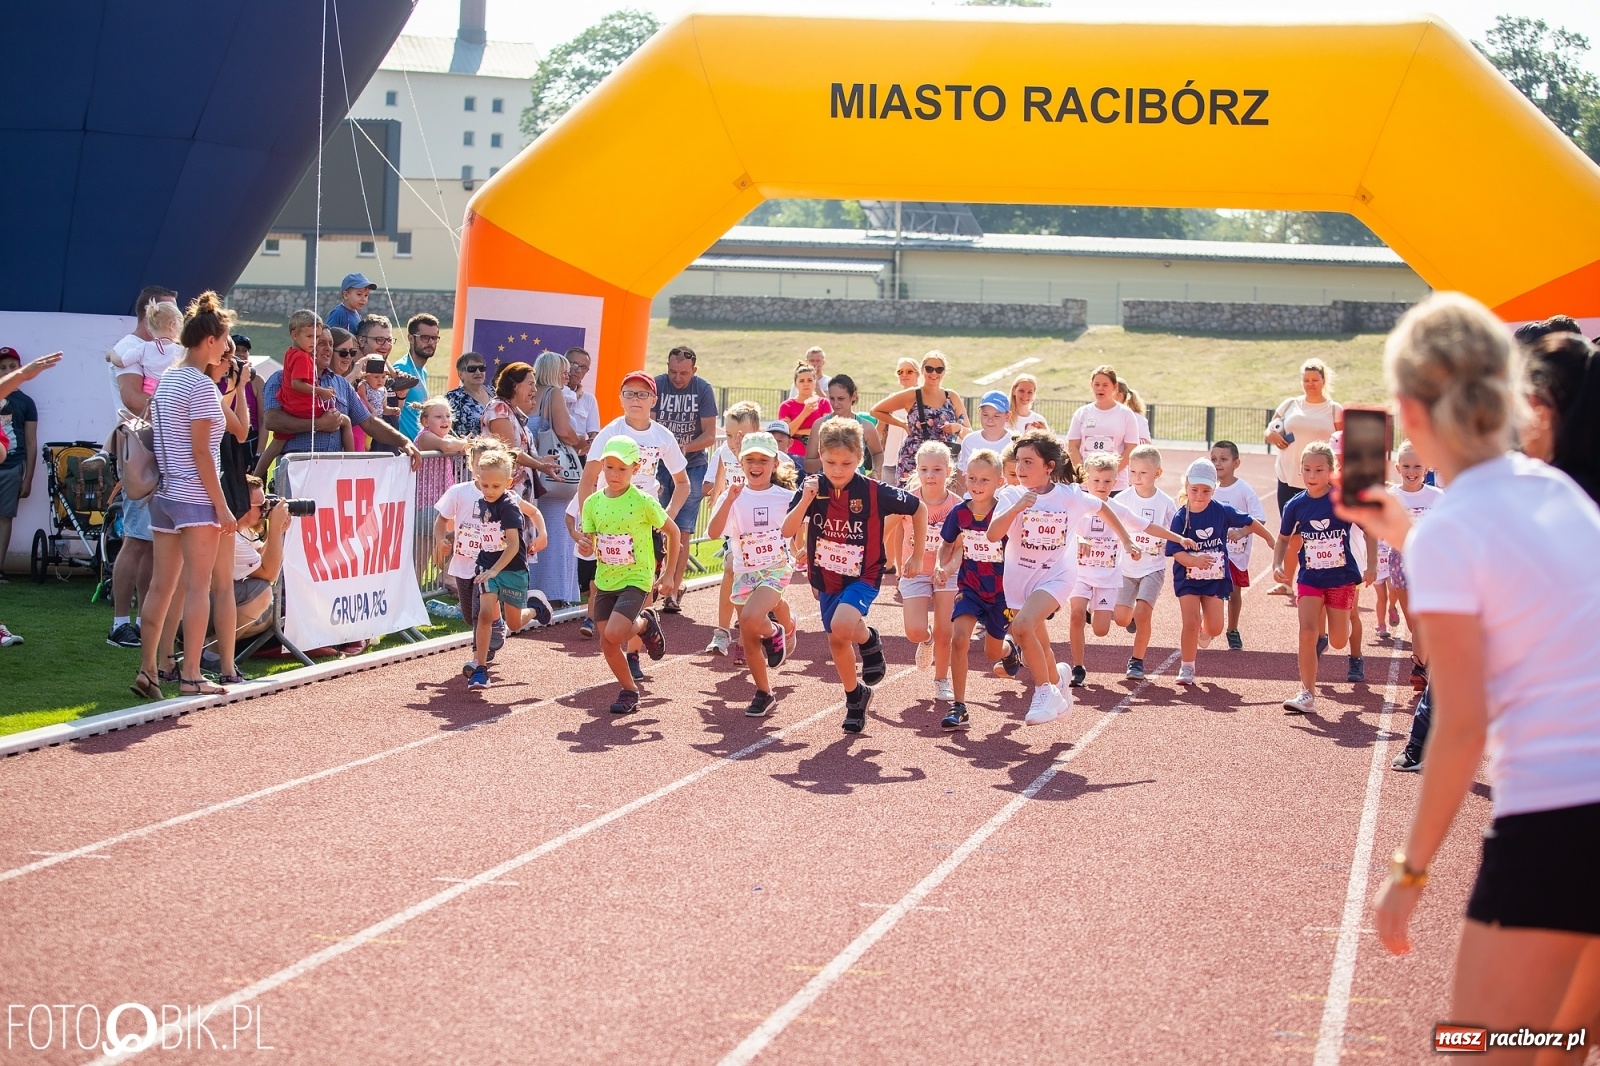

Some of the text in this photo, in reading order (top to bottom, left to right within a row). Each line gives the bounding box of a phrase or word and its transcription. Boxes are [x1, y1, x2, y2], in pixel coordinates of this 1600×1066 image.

[830, 80, 1269, 126] MIASTO RACIBÓRZ
[660, 393, 698, 412] VENICE
[660, 411, 696, 422] BEACH
[668, 421, 696, 433] ANGELES
[1093, 441, 1105, 450] 88
[732, 475, 746, 484] 047
[813, 513, 864, 533] QATAR
[821, 529, 864, 540] AIRWAYS
[1037, 525, 1057, 535] 040
[1300, 528, 1348, 541] FRUTAVITA
[1135, 535, 1151, 544] 025
[605, 546, 622, 556] 082
[755, 544, 774, 555] 038
[973, 543, 990, 552] 055
[829, 553, 848, 565] 052
[1091, 550, 1106, 558] 199
[1316, 551, 1333, 559] 006
[330, 592, 370, 626] GRUPA
